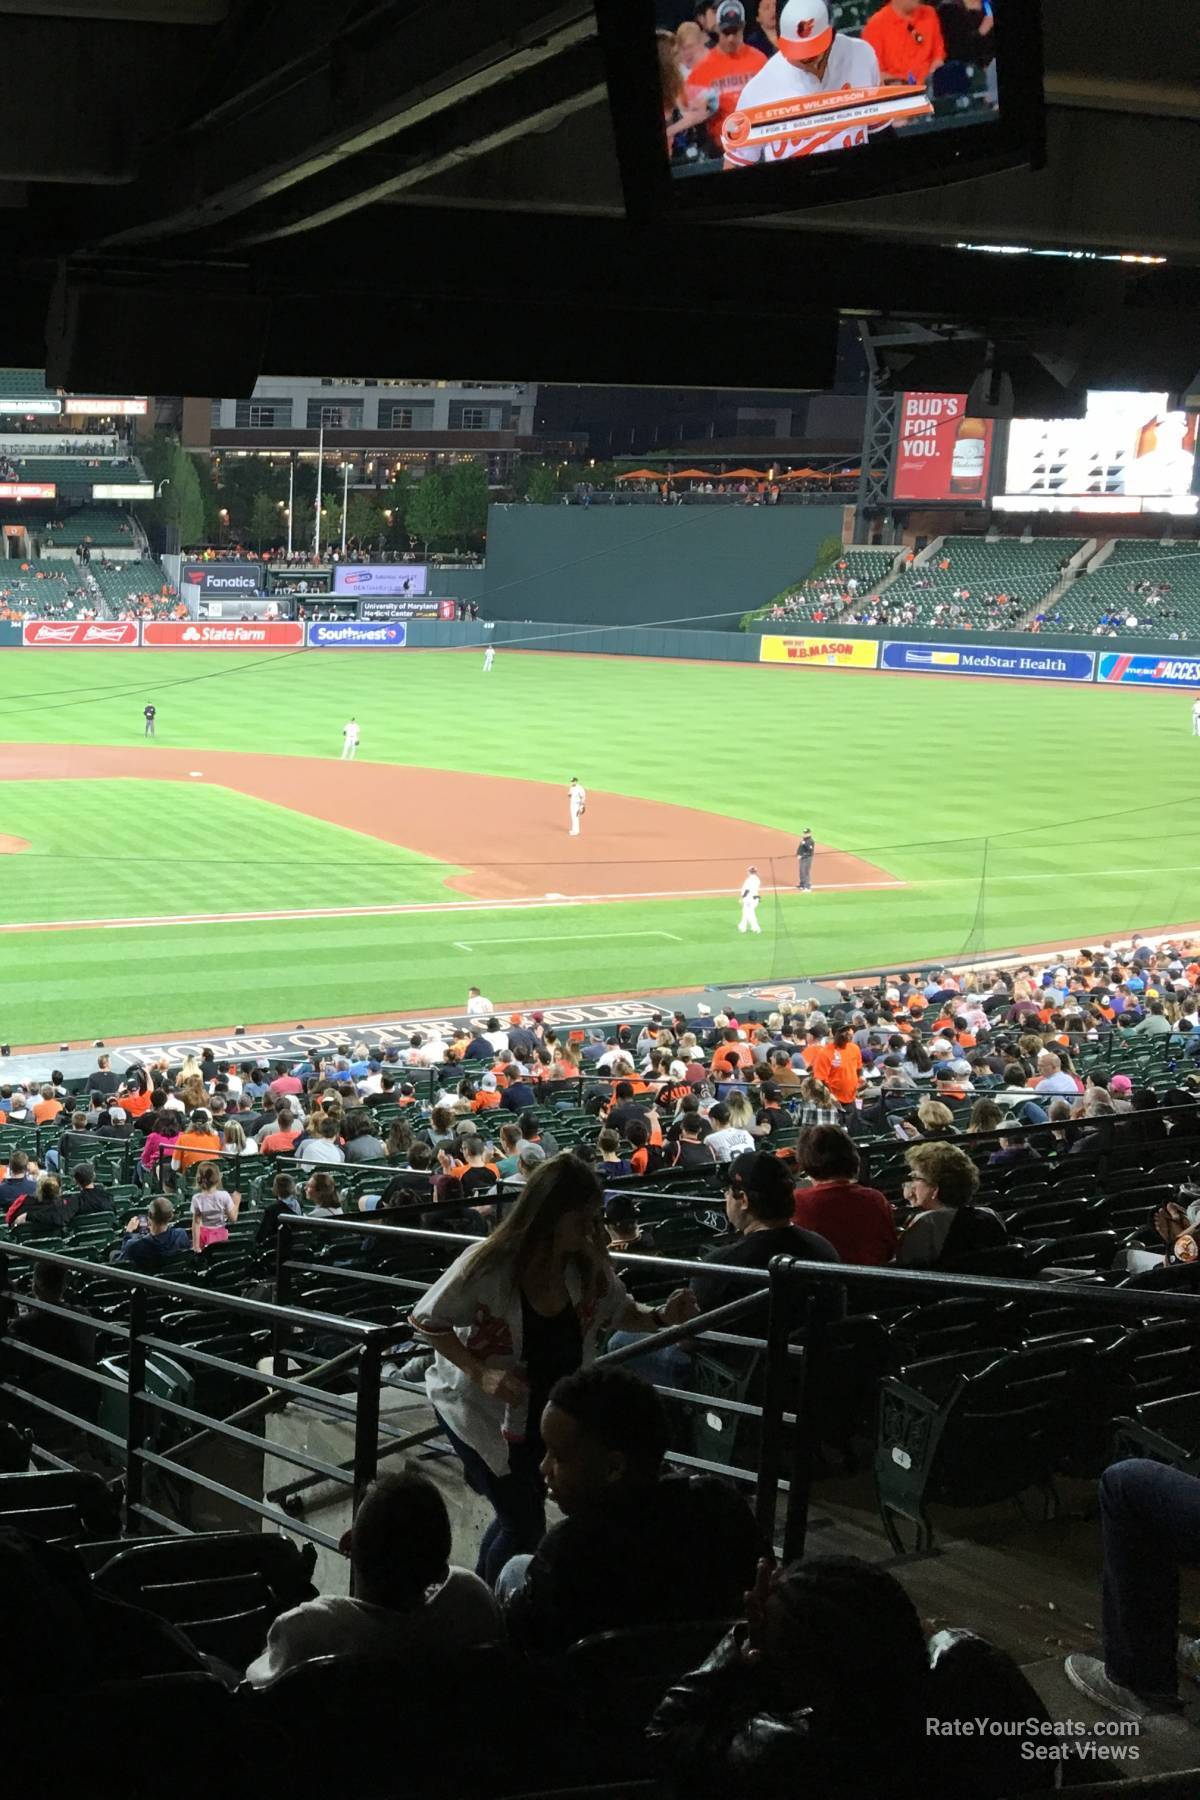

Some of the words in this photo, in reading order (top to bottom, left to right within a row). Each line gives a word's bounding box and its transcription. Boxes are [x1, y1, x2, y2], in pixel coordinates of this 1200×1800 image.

[766, 103, 801, 119] STEVIE
[803, 91, 864, 111] WILKERSON
[906, 398, 958, 417] BUD'S
[904, 419, 938, 437] FOR
[902, 440, 941, 457] YOU.
[207, 575, 256, 588] Fanatics
[364, 603, 398, 611] University
[408, 603, 439, 612] Maryland
[391, 610, 414, 618] Center
[318, 627, 386, 642] Southwest
[962, 655, 1017, 669] MedStar
[1019, 657, 1067, 671] Health
[703, 1210, 718, 1227] 28
